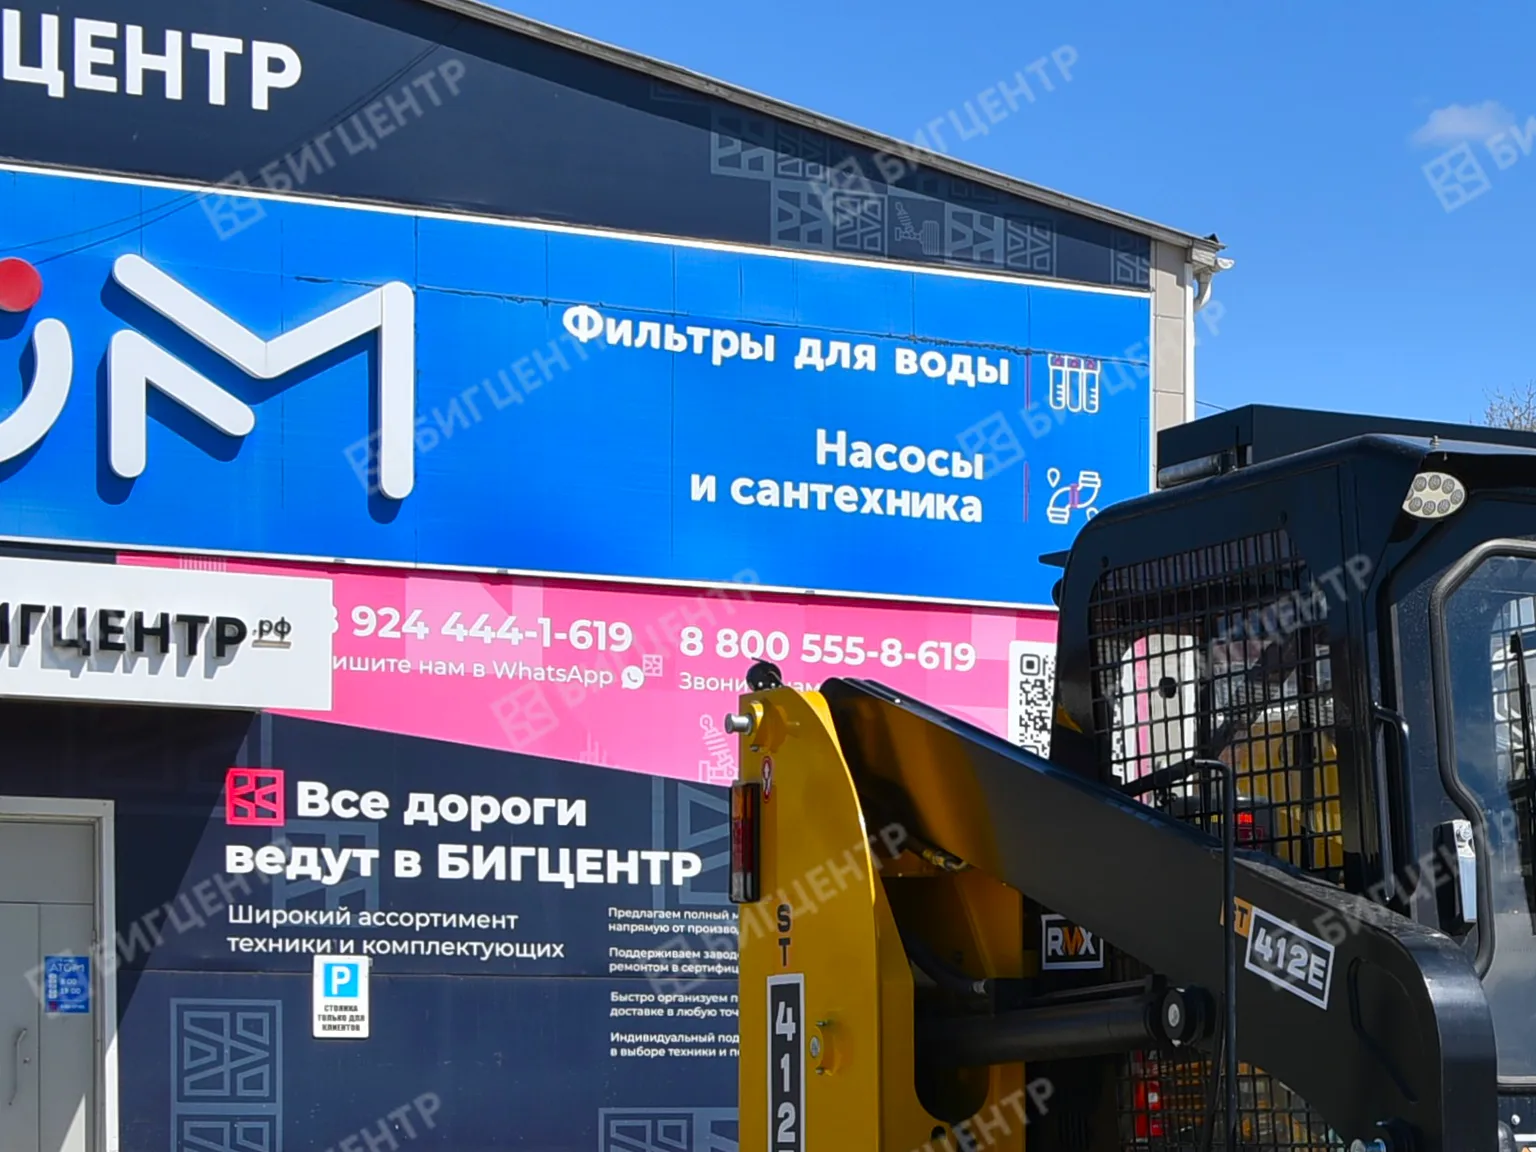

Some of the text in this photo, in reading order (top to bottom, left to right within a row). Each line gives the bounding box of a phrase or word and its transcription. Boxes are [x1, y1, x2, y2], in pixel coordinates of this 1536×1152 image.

[2, 8, 301, 111] ЦЕНТР
[561, 304, 1010, 388] Фильтры для воды
[816, 428, 985, 481] Насосы
[690, 473, 983, 523] и сантехника
[351, 604, 430, 640] 924
[440, 610, 633, 652] 444-1-619
[679, 626, 977, 672] 8 800 555-8-619
[418, 659, 464, 677] нам
[472, 665, 485, 677] в
[493, 660, 614, 689] WhatsApp
[297, 781, 587, 832] Все дороги
[226, 843, 702, 889] ведут в БИГЦЕНТР
[228, 904, 519, 931] Широкий ассортимент
[608, 907, 681, 920] Предлагаем
[684, 910, 729, 921] полный
[608, 923, 670, 934] напрямую
[672, 925, 684, 933] от
[227, 936, 565, 961] техники и комплектующих
[609, 947, 700, 960] Поддерживаем
[1254, 927, 1327, 991] 412E
[609, 963, 669, 973] ремонтом
[671, 964, 678, 972] в
[610, 991, 655, 1004] Быстро
[657, 994, 728, 1005] организуем
[317, 1014, 347, 1022] ТОЛЬКО
[610, 1006, 664, 1018] доставке
[676, 1006, 717, 1019] любую
[610, 1032, 715, 1044] Индивидуальный
[620, 1047, 666, 1058] выборе
[668, 1049, 716, 1057] техники
[719, 1049, 727, 1057] и
